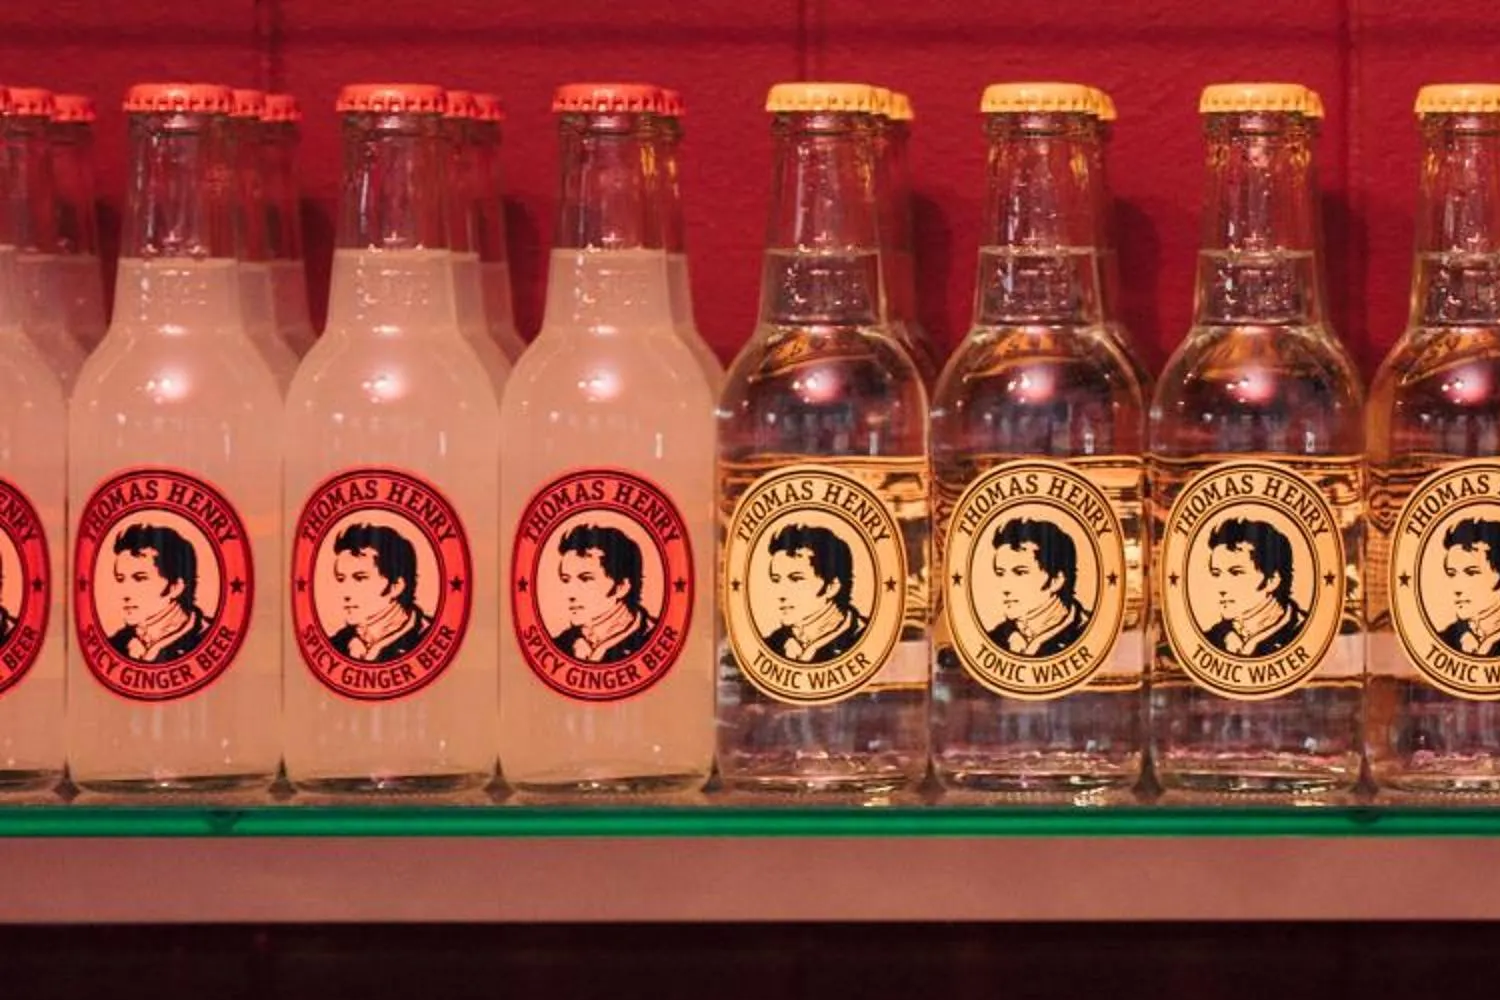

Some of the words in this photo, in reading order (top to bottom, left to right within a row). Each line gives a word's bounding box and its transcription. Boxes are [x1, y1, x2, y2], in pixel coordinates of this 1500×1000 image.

[0, 491, 38, 541] NRY
[84, 480, 160, 542] THOMAS
[165, 482, 240, 545] HENRY
[303, 480, 378, 544] THOMAS
[384, 482, 458, 544] HENRY
[525, 480, 605, 546] THOMAS
[612, 482, 682, 546] HENRY
[737, 480, 814, 545] THOMAS
[821, 482, 893, 545] HENRY
[957, 474, 1039, 538] THOMAS
[1046, 476, 1113, 538] HENRY
[1173, 474, 1255, 538] THOMAS
[1262, 476, 1331, 538] HENRY
[1405, 474, 1489, 538] THOMAS
[2, 625, 37, 671] BEER
[83, 624, 119, 675] SPICY
[119, 664, 195, 689] GINGER
[200, 626, 237, 674] BEER
[301, 625, 339, 677] SPICY
[340, 666, 416, 689] GINGER
[419, 625, 456, 673] BEER
[523, 625, 564, 676] SPICY
[565, 666, 642, 689] GINGER
[645, 625, 679, 673] BEER
[752, 651, 801, 689] TONIC
[808, 651, 872, 689] WATER
[975, 644, 1025, 683] TONIC
[1032, 645, 1095, 683] WATER
[1192, 644, 1242, 683] TONIC
[1249, 645, 1311, 684] WATER
[1425, 644, 1478, 684] TONIC
